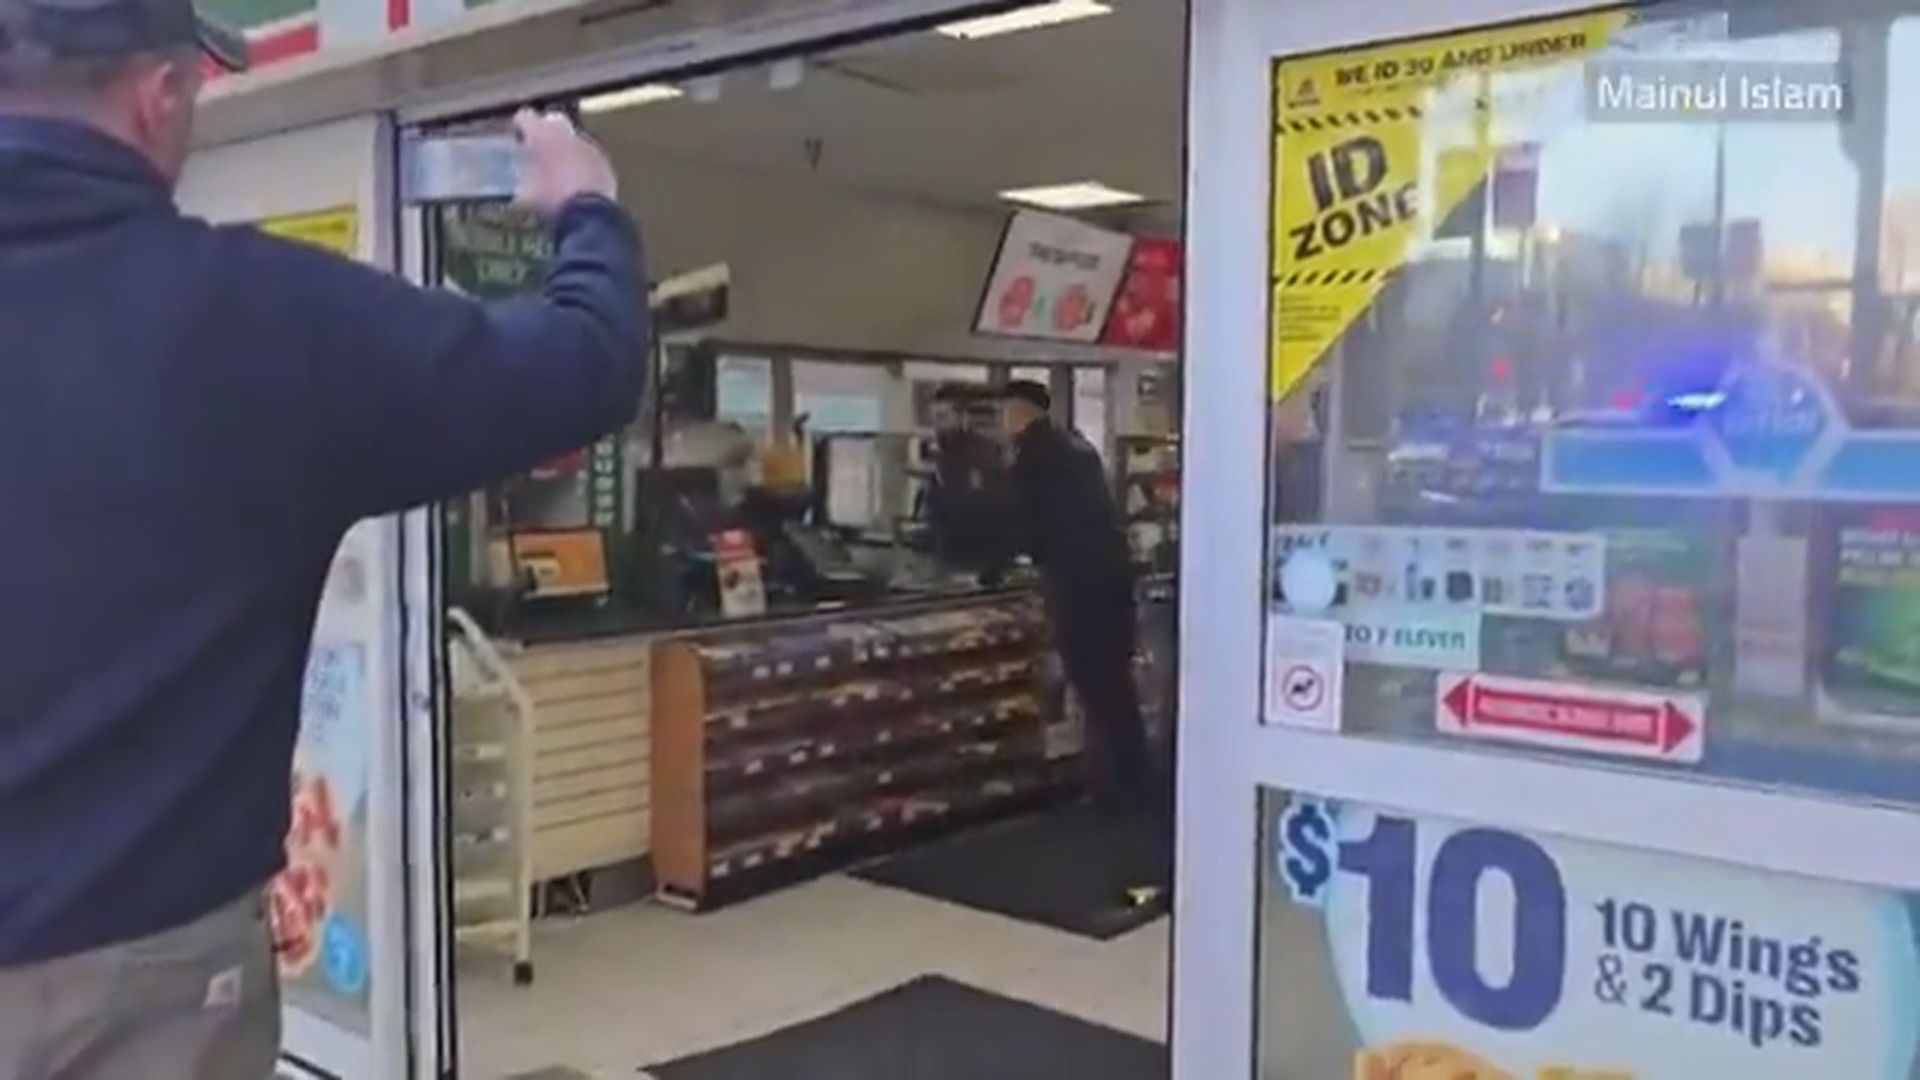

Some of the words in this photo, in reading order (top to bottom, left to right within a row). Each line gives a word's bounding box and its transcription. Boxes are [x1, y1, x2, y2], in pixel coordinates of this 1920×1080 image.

[1334, 66, 1367, 86] WE
[1375, 61, 1399, 80] ID
[1405, 57, 1434, 75] 30
[1440, 47, 1490, 69] AND
[1499, 33, 1586, 62] UNDER
[1308, 136, 1388, 212] ID
[1288, 182, 1418, 261] ZONE
[1286, 804, 1567, 1032] $10
[1594, 897, 1656, 952] 10
[1671, 910, 1859, 998] Wings
[1594, 954, 1627, 1007] &
[1640, 962, 1673, 1016] 2
[1690, 970, 1822, 1048] Dips
